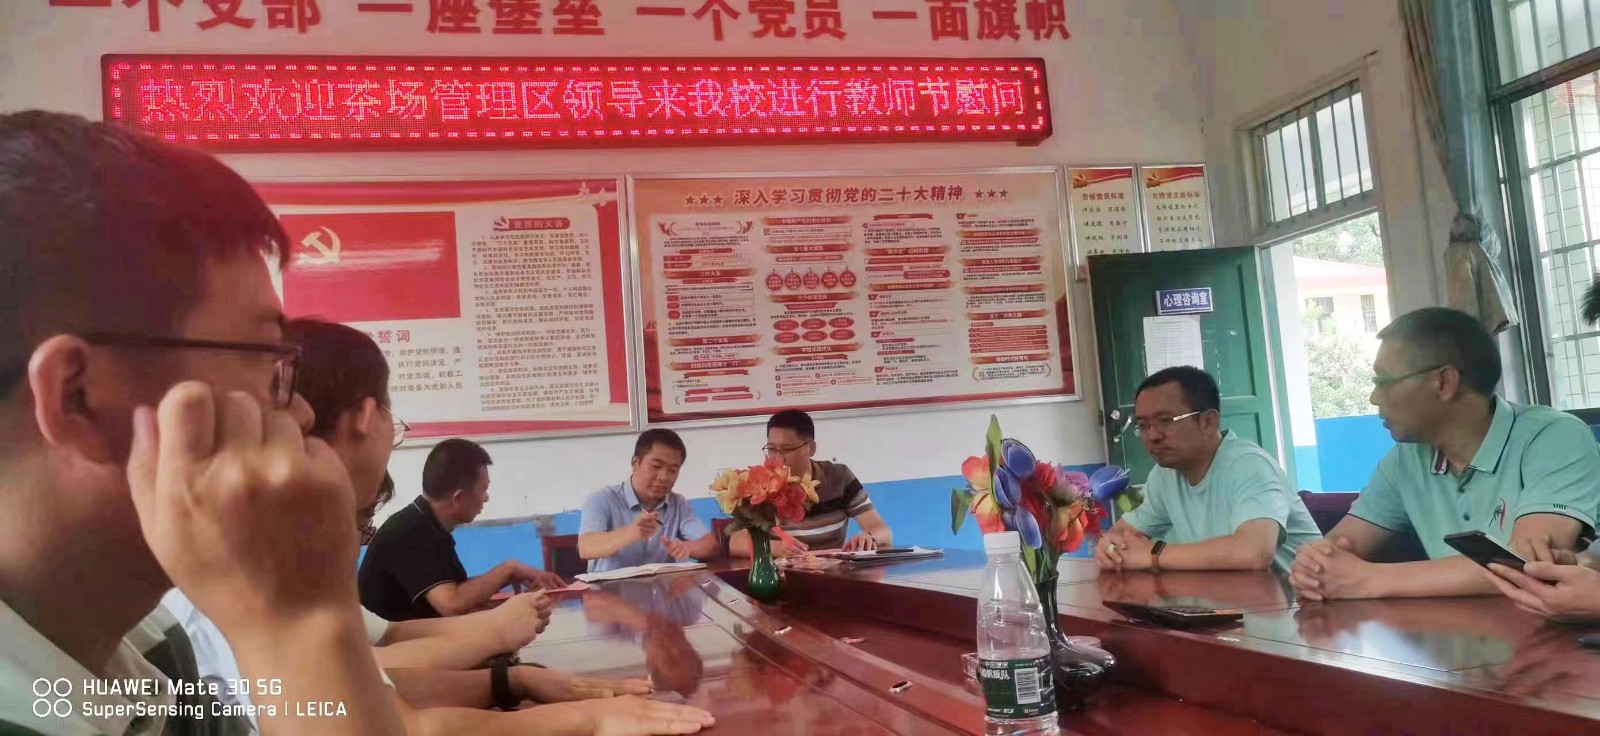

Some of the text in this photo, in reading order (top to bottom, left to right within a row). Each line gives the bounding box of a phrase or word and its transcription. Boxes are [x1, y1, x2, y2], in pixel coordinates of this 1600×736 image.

[49, 0, 1070, 41] 一个支部 一座堡垒 一个党员 一面旗帜
[140, 76, 1025, 124] 热烈欢迎茶场管理区领导来我校进行教师节慰问
[734, 185, 963, 205] 深入学习贯彻党的二十大精神
[1163, 291, 1209, 307] 心理咨询室
[367, 330, 410, 343] 誓词
